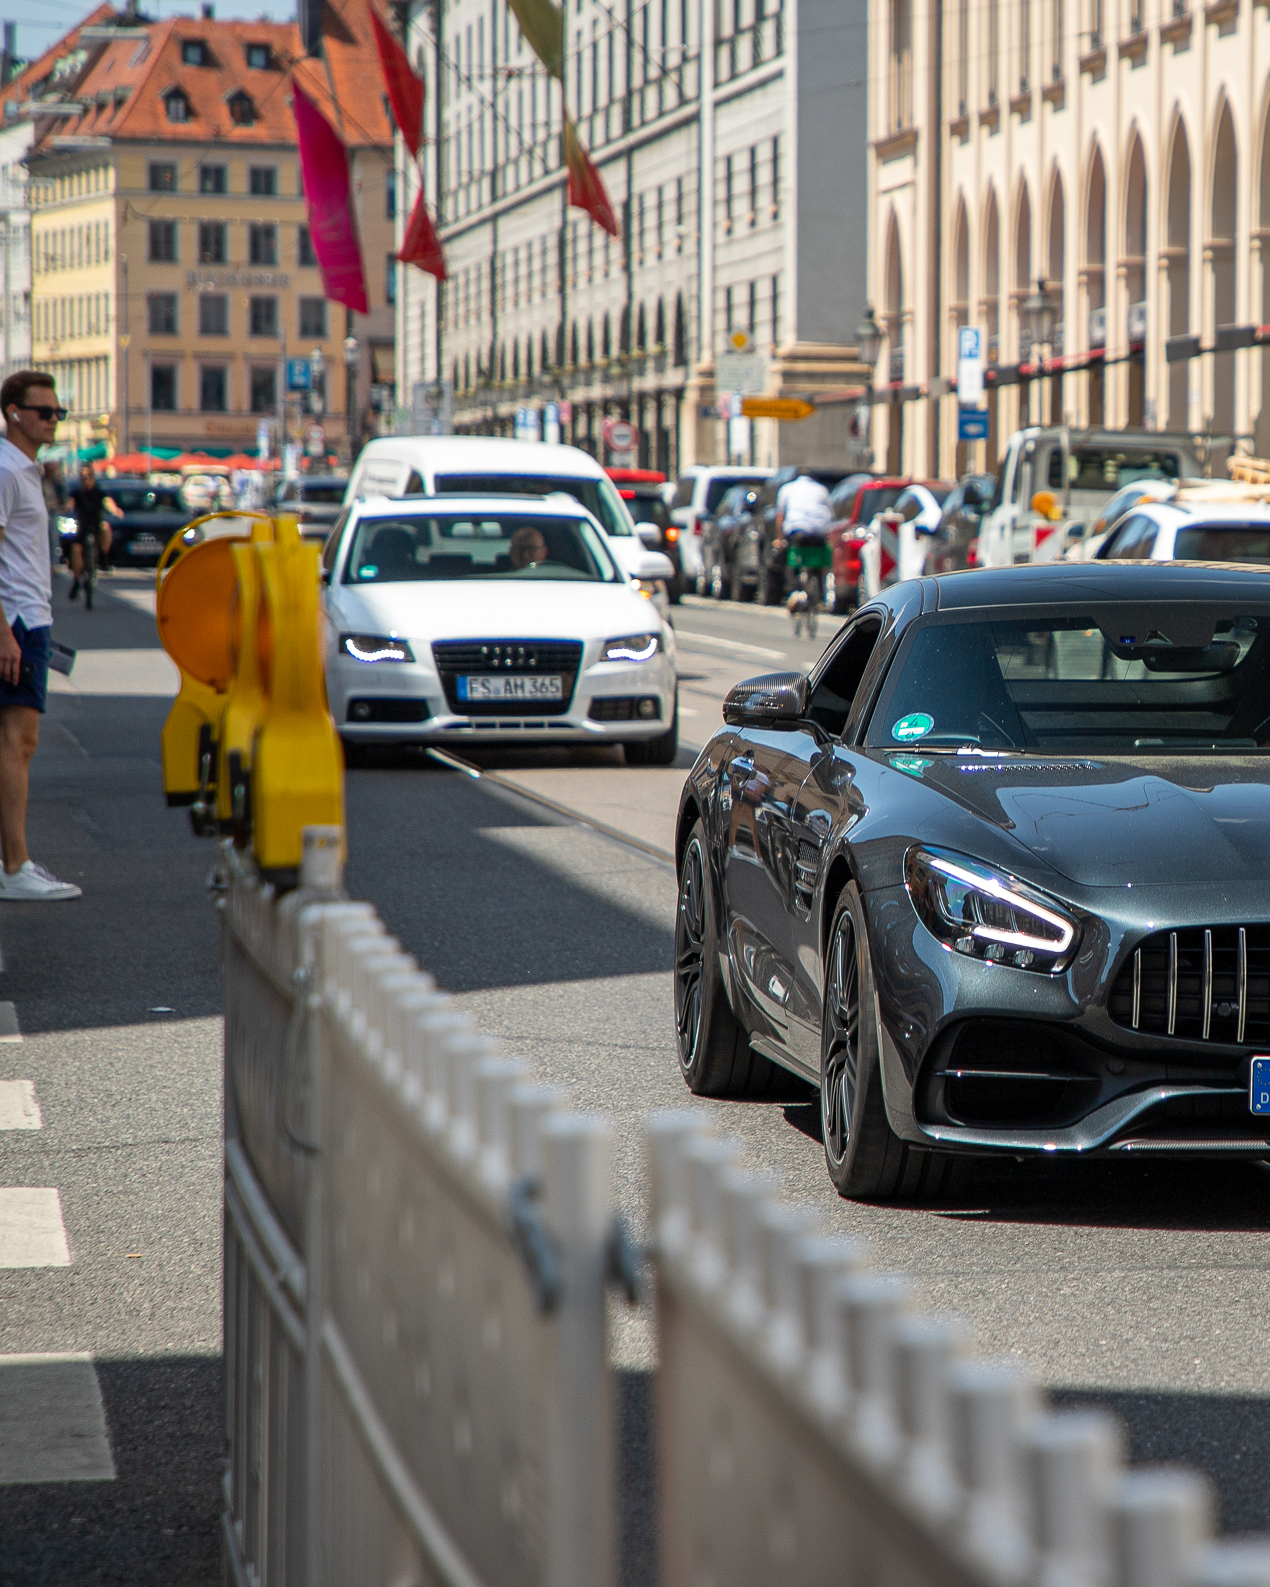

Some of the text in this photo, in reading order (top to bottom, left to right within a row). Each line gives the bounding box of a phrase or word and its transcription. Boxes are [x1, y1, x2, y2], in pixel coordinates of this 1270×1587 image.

[469, 677, 560, 695] FS AH 365
[1260, 1093, 1269, 1103] D
